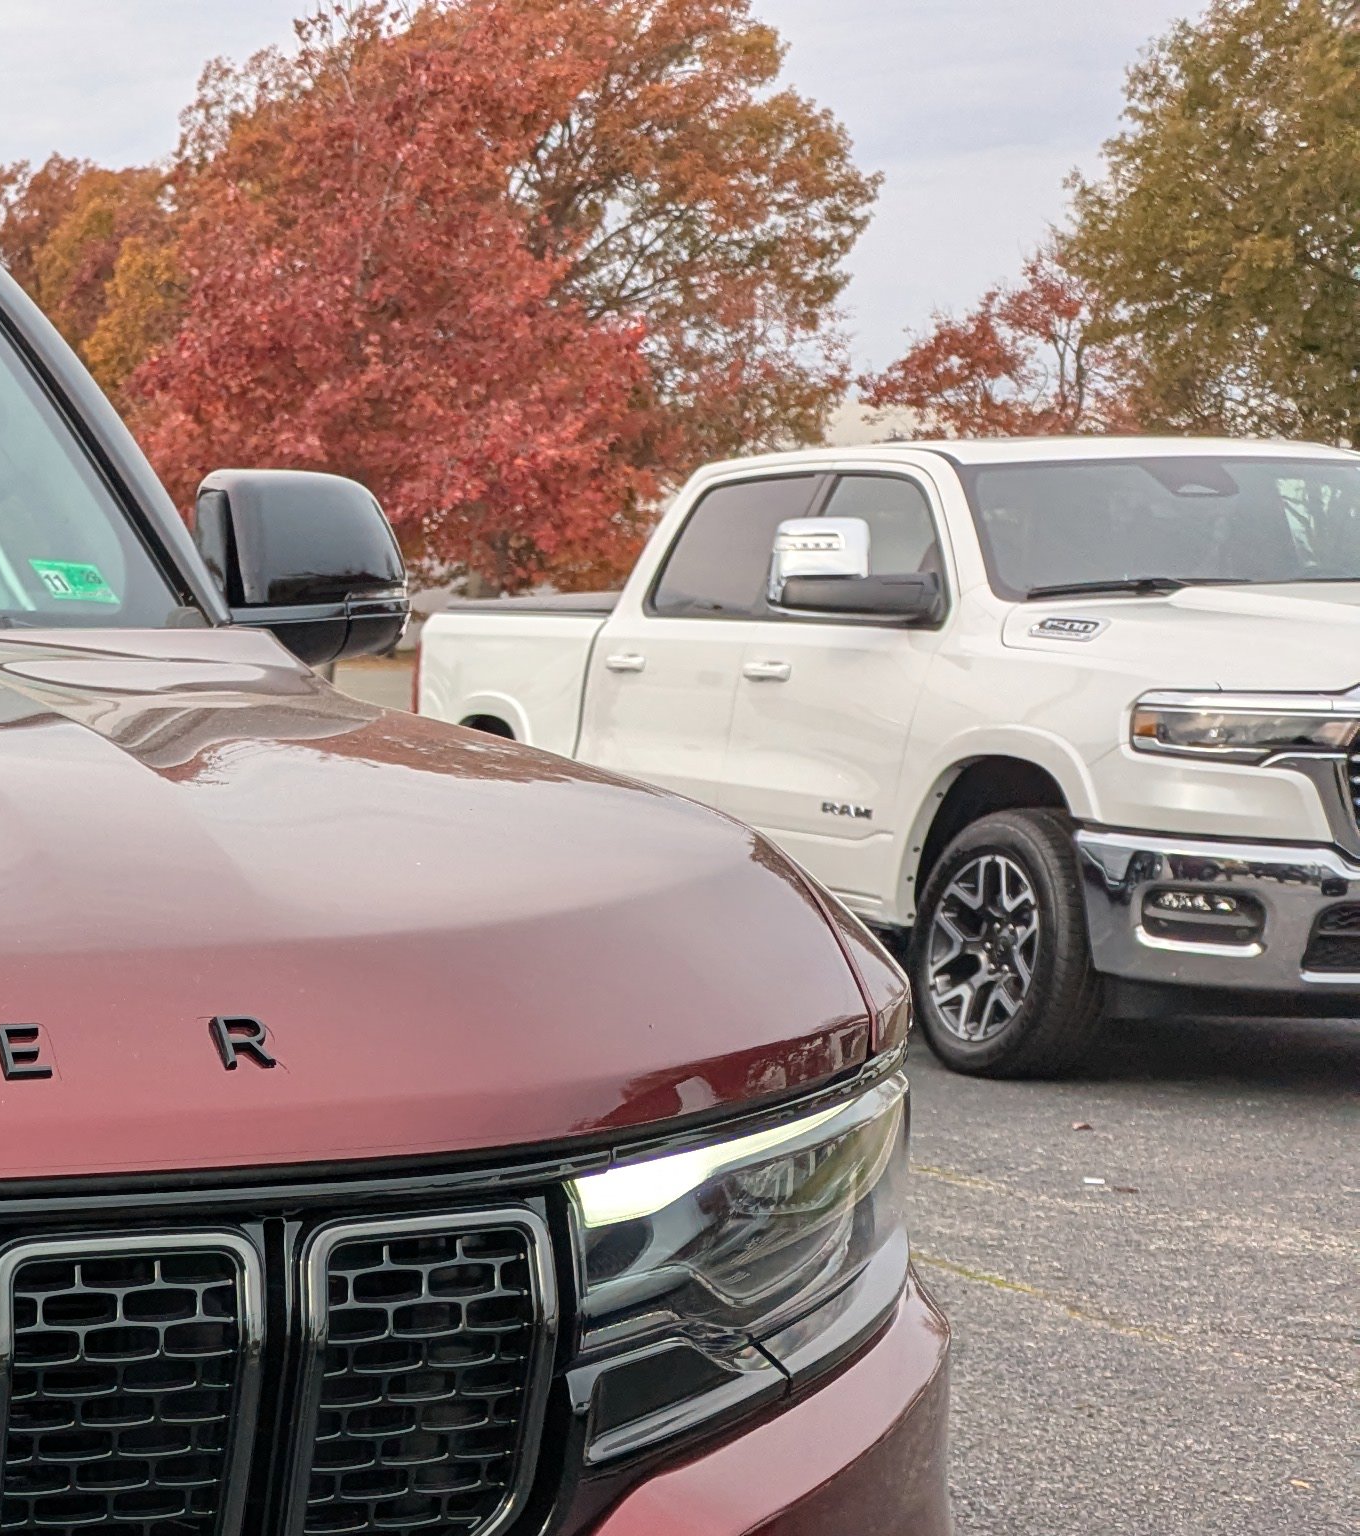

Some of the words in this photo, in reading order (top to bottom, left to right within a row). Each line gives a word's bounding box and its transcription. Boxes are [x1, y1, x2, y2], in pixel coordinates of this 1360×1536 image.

[44, 574, 69, 592] 11
[1043, 620, 1095, 633] 1500
[821, 801, 873, 820] RAM
